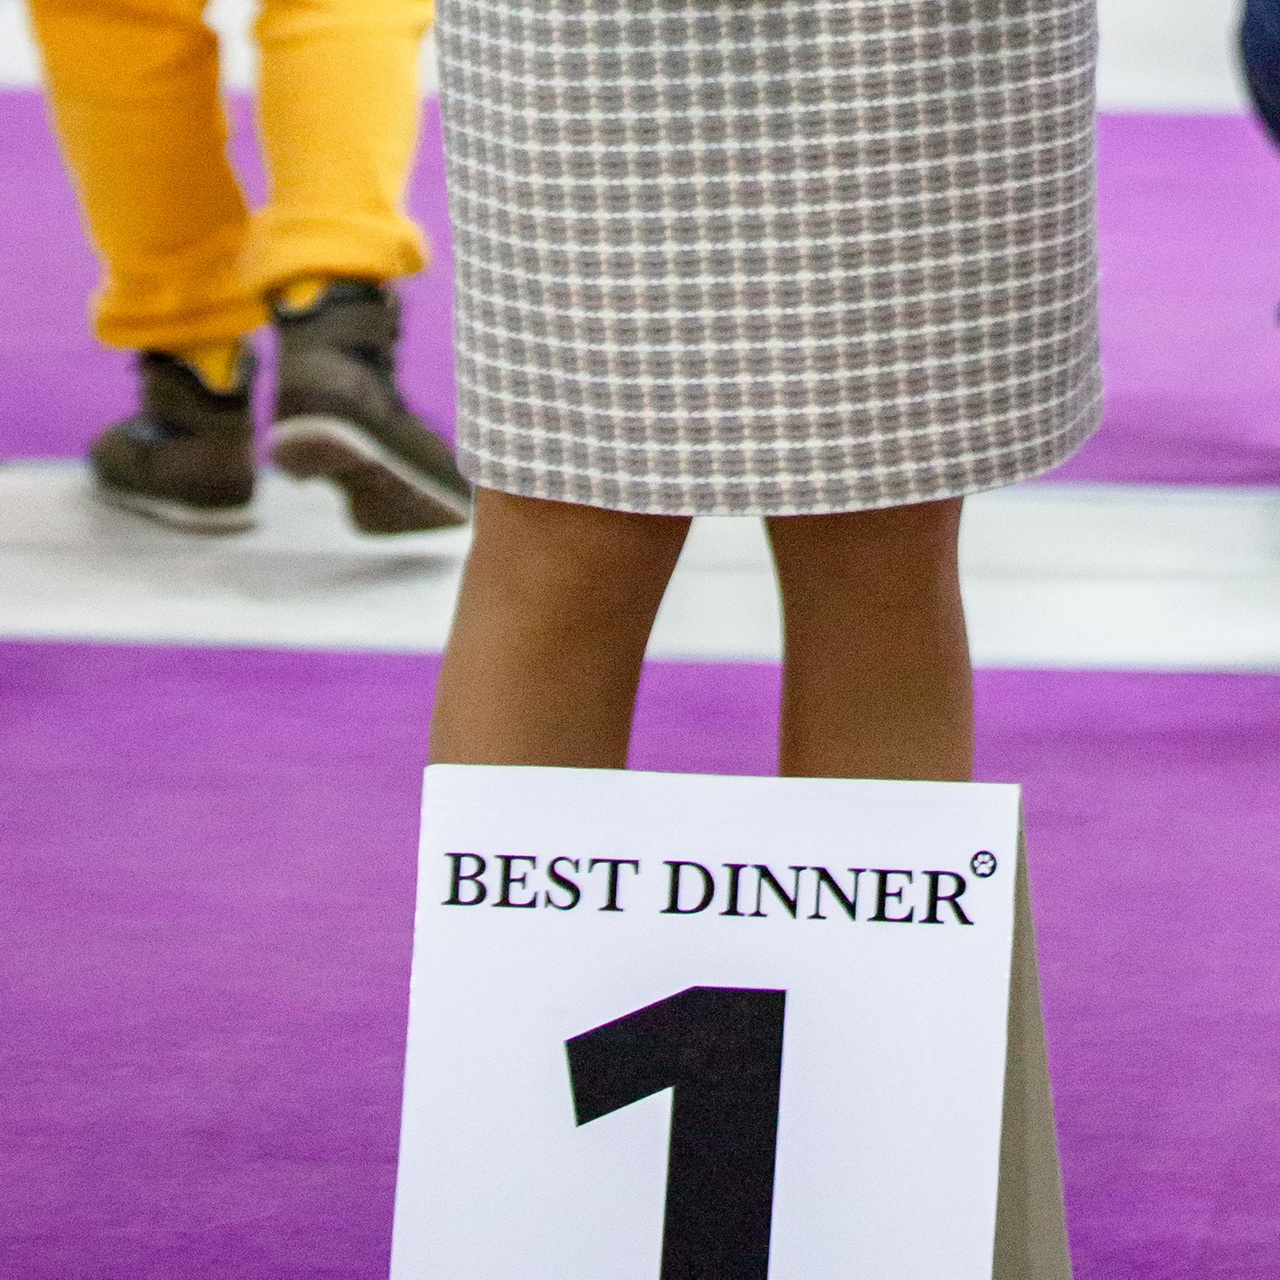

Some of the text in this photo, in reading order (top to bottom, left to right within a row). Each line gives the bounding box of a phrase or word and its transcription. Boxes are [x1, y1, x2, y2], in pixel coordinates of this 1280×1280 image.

[441, 852, 975, 926] BEST DINNER
[564, 985, 787, 1280] 1
